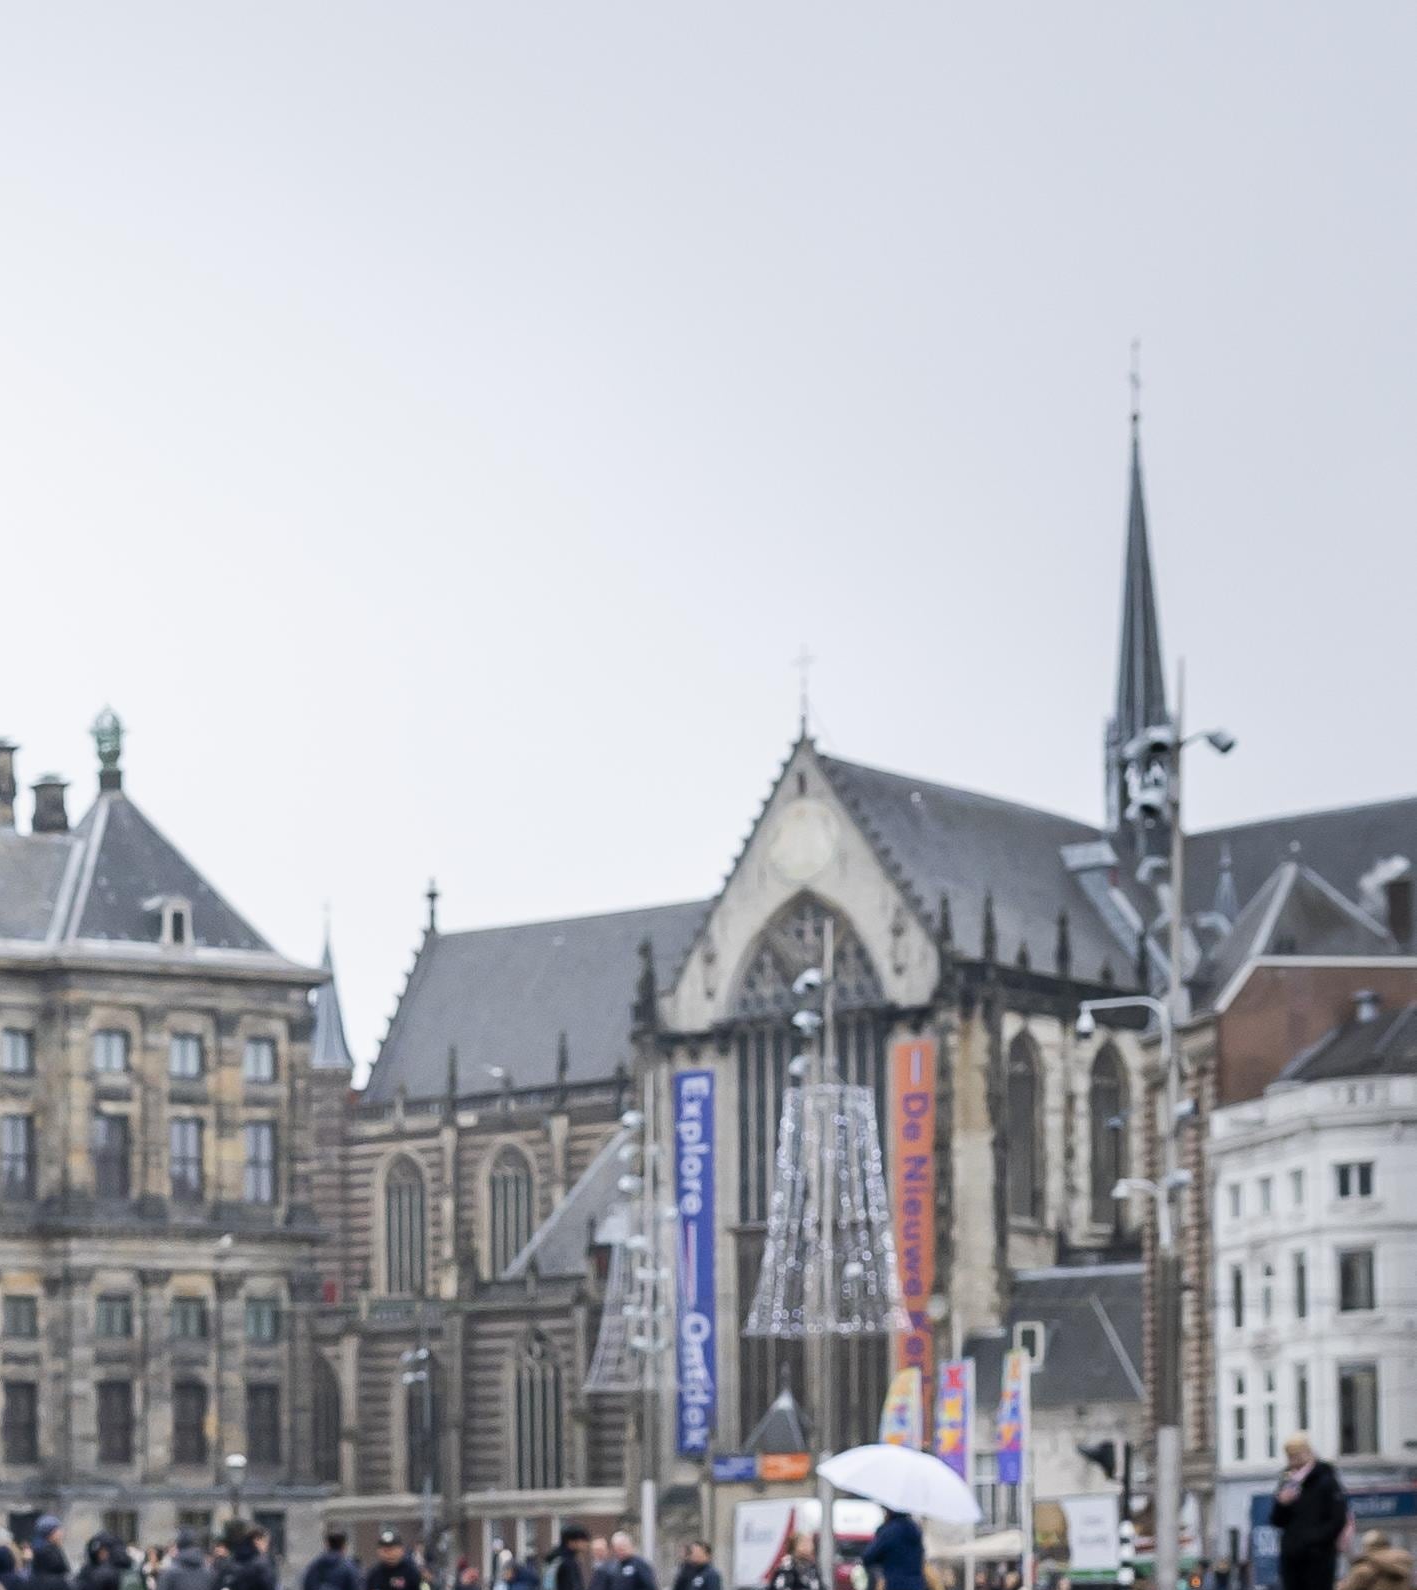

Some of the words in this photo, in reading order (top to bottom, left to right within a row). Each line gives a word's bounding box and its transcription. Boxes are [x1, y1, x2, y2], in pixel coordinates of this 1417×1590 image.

[678, 1076, 711, 1217] Explore
[902, 1091, 930, 1143] De
[902, 1155, 931, 1296] Nieuwe
[682, 1311, 713, 1449] Ontdek
